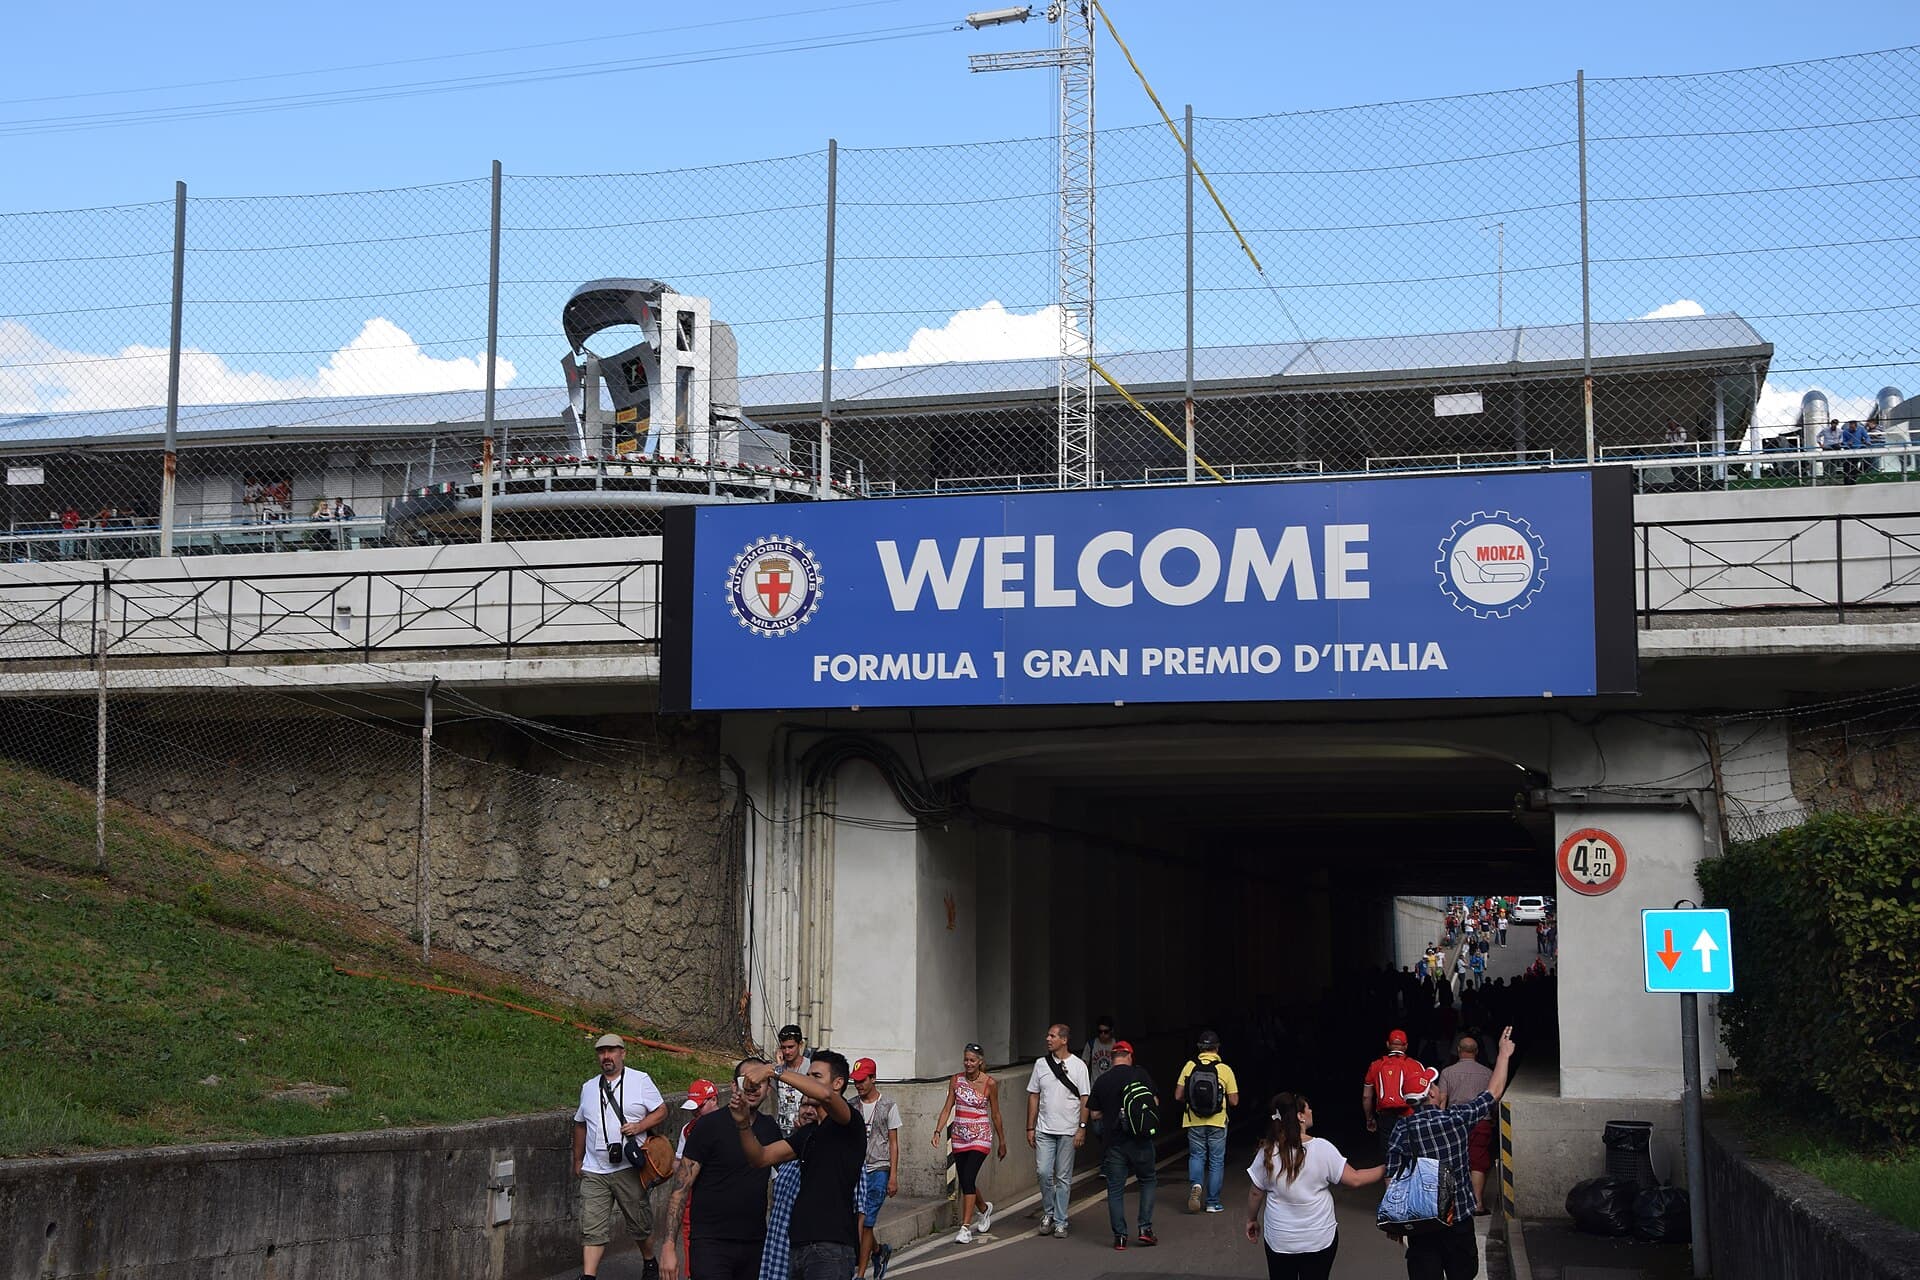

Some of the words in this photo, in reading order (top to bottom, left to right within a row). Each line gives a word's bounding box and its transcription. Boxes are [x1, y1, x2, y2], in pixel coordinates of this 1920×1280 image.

[733, 543, 794, 594] AUTOMOBILE
[800, 557, 817, 592] CLUB
[875, 523, 1370, 612] WELCOME
[1476, 544, 1526, 562] MONZA
[750, 615, 798, 629] MILANO
[813, 653, 978, 682] FORMULA
[993, 651, 1005, 678] 1
[1023, 649, 1128, 678] GRAN
[1142, 645, 1281, 675] PREMIO
[1294, 642, 1449, 673] D'ITALIA
[1573, 845, 1588, 876] 4
[1595, 847, 1606, 860] m
[1593, 863, 1611, 877] 20
